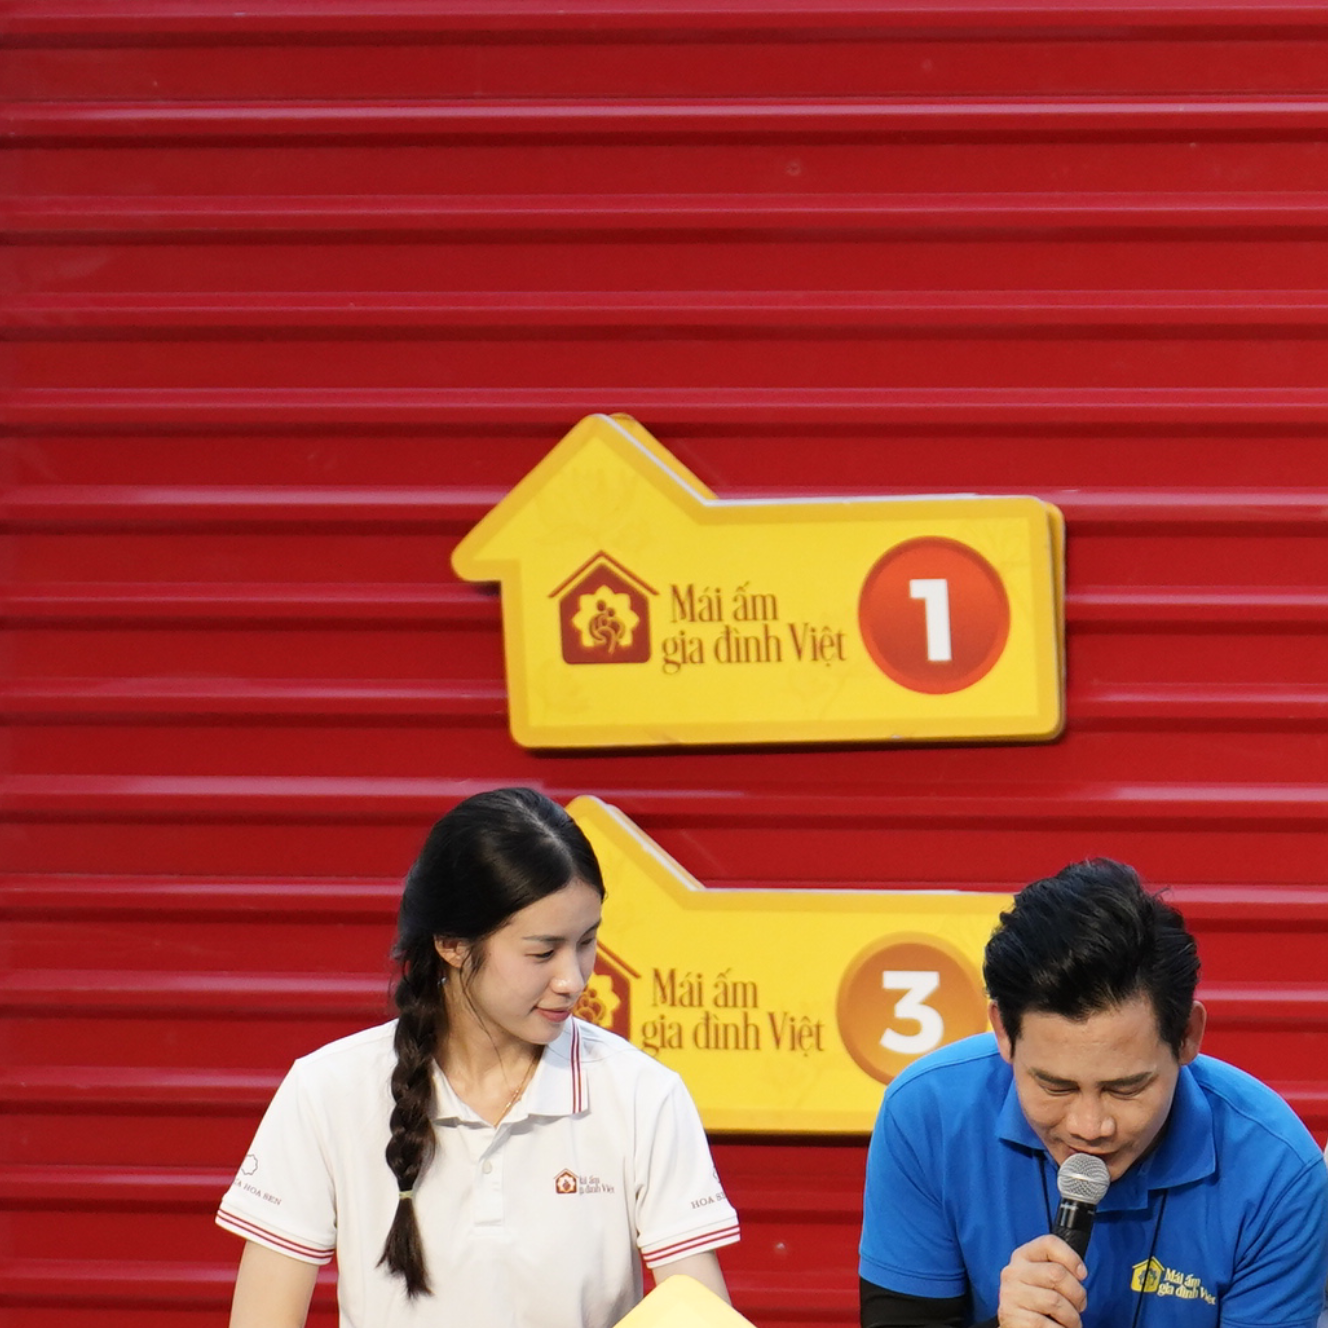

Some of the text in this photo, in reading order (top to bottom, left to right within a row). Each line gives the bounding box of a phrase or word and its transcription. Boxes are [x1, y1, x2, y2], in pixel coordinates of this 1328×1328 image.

[669, 582, 779, 624] Mái ấm
[909, 578, 953, 663] 1
[661, 623, 848, 674] gia đình Việt
[652, 967, 759, 1009] Mái ấm
[641, 1011, 825, 1058] gia đình Việt
[879, 970, 945, 1055] 3
[691, 1196, 715, 1209] HOA
